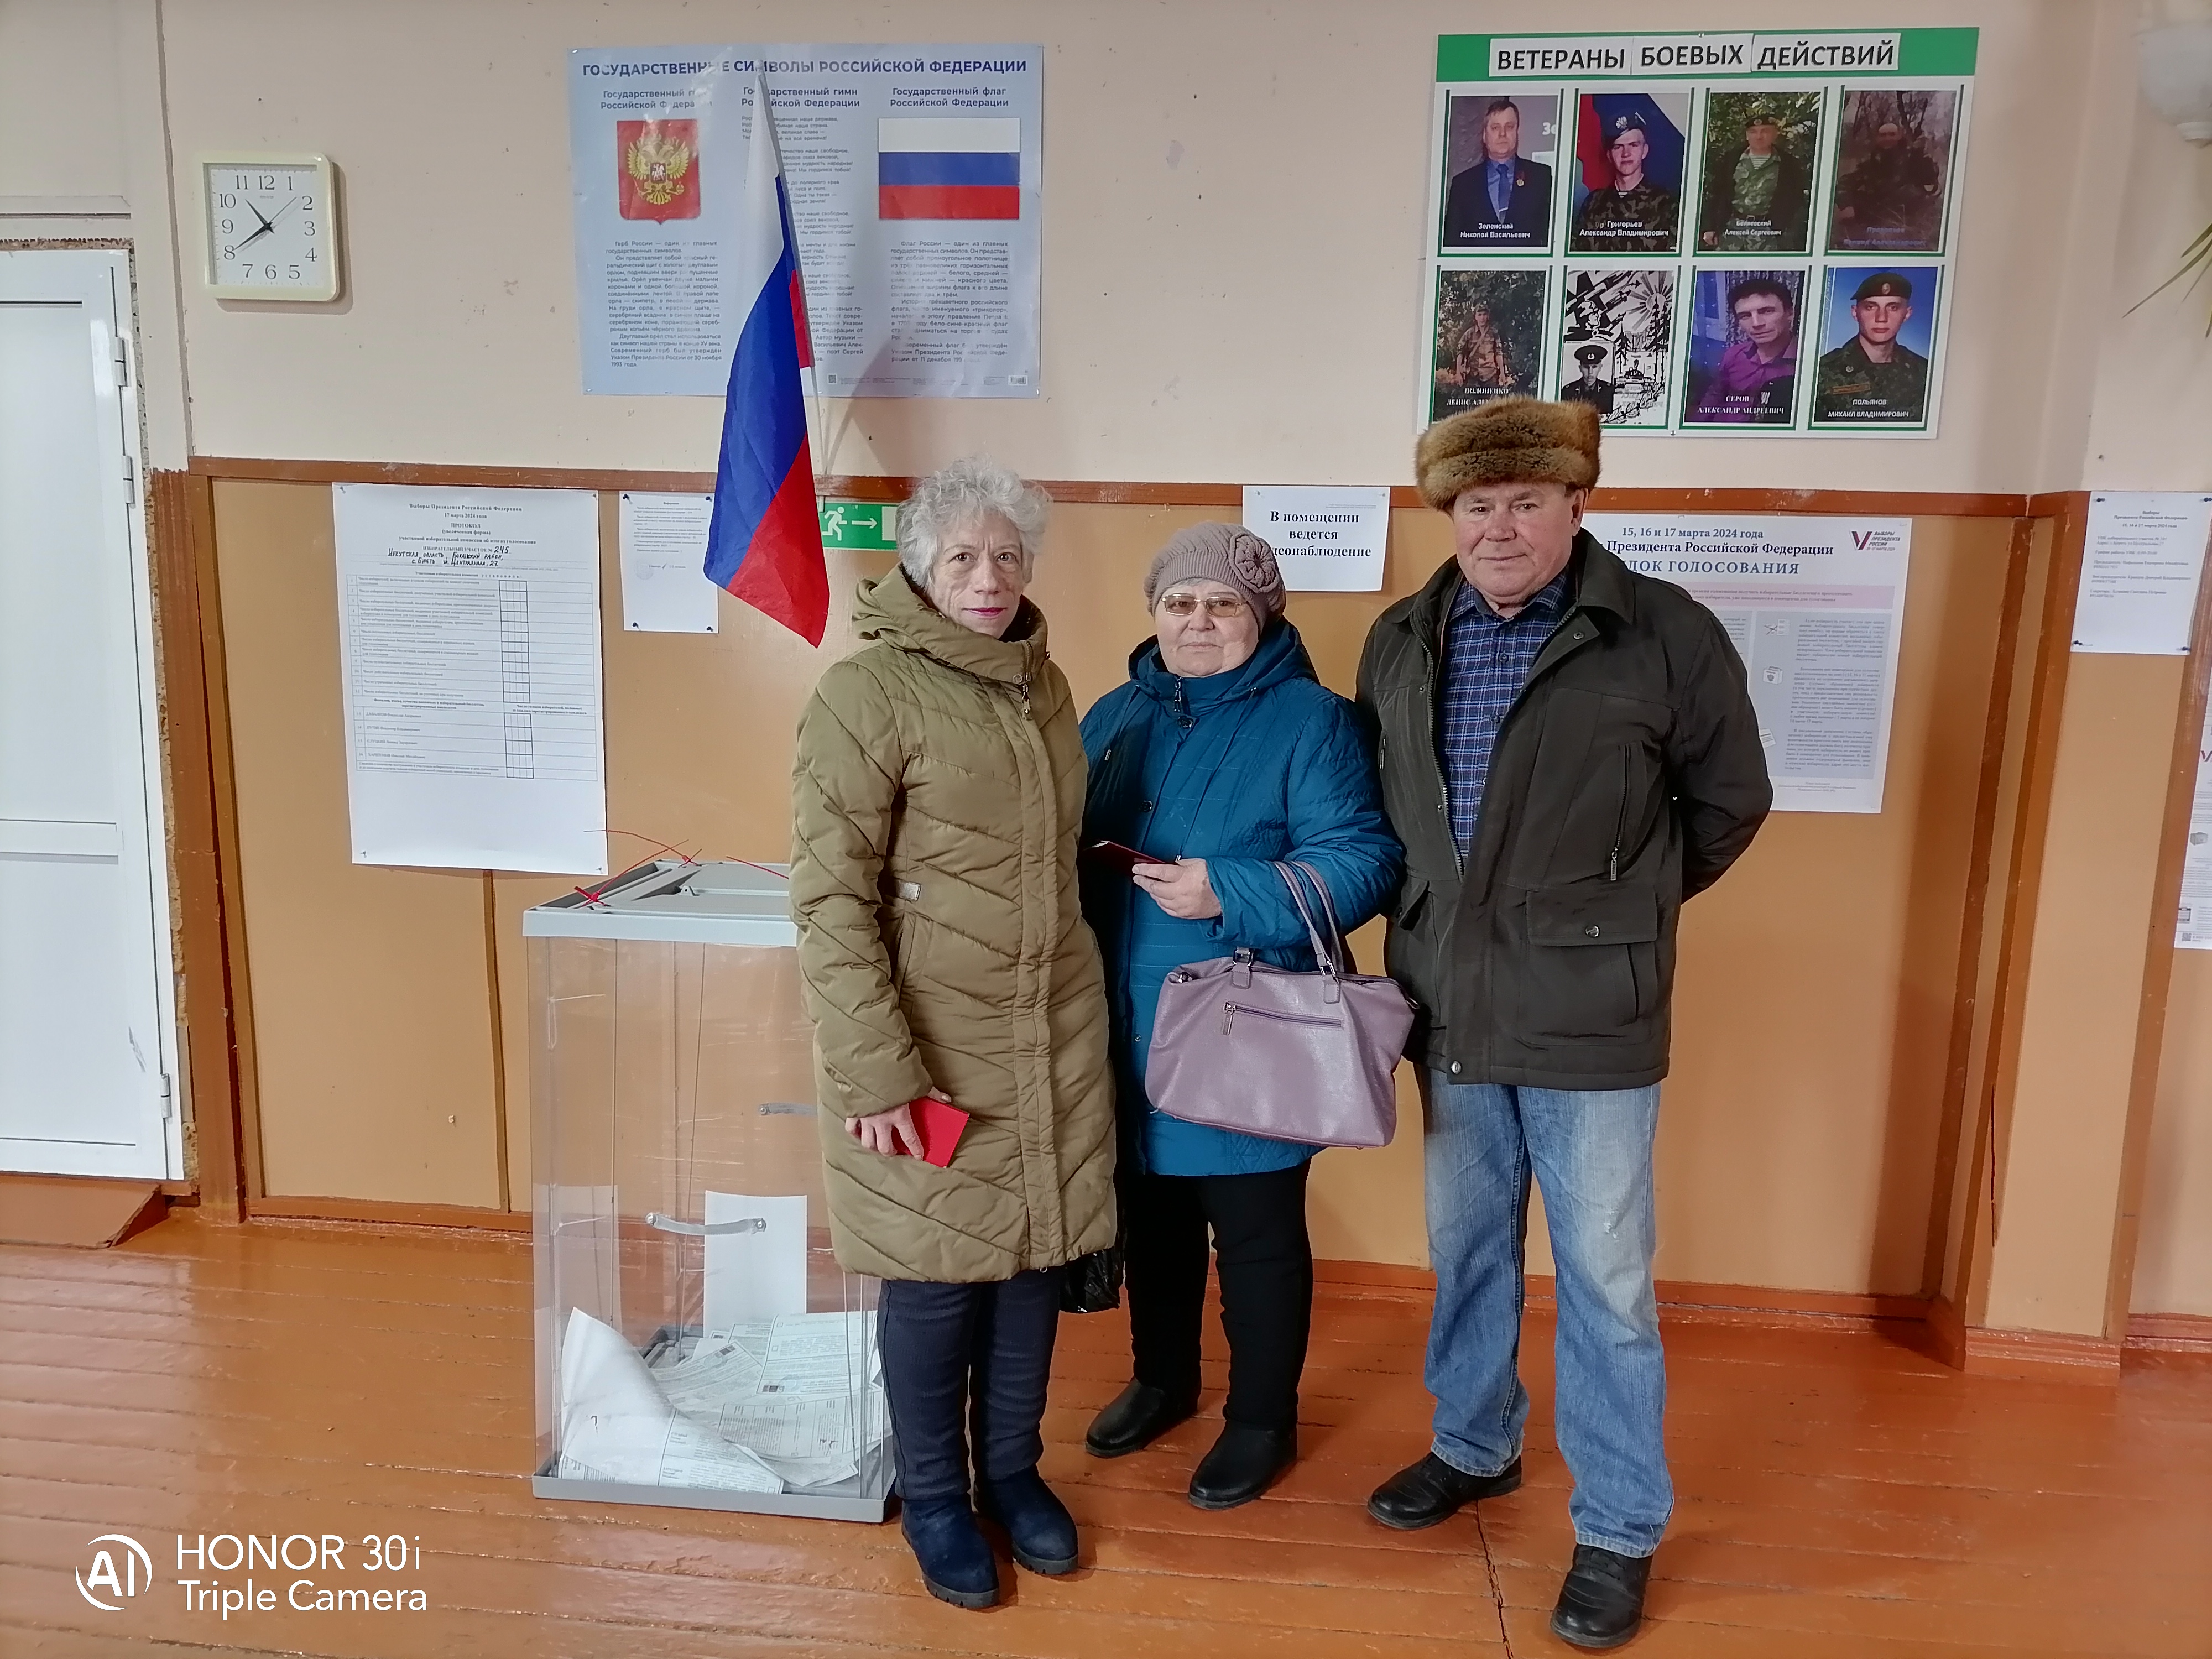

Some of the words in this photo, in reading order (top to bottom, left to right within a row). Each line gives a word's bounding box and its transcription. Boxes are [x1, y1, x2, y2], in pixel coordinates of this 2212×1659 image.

[1498, 49, 1624, 70] ВЕТЕРАНЫ
[1641, 45, 1743, 66] БОЕВЫХ
[1757, 40, 1893, 70] ДЕЙСТВИЙ
[583, 61, 730, 77] ГОСУДАРСТВЕННЕ
[820, 58, 924, 72] РОССИЙСКОЙ
[930, 61, 1026, 74] ФЕДЕРАЦИИ
[604, 90, 684, 100] Государственный
[893, 87, 978, 97] Государственный
[983, 87, 1006, 97] флаг
[601, 99, 656, 110] Российской
[804, 100, 859, 108] Федерации
[890, 98, 947, 107] Российской
[952, 99, 1008, 108] Федерации
[236, 175, 248, 190] 11
[259, 175, 274, 190] 12
[288, 176, 293, 191] 1
[220, 194, 236, 208] 10
[302, 196, 312, 210] 2
[222, 219, 233, 233] 9
[304, 221, 315, 236] 3
[224, 246, 236, 259] 8
[305, 248, 317, 262] 4
[242, 264, 253, 278] 7
[265, 265, 276, 279] 6
[289, 265, 300, 279] 5
[1271, 511, 1279, 521] В
[1284, 514, 1358, 524] помещении
[1290, 531, 1337, 540] ведется
[1623, 528, 1636, 538] 15,
[1641, 528, 1651, 536] 16
[1665, 528, 1676, 536] 17
[1678, 530, 1710, 539] марта
[1713, 529, 1737, 538] 2024
[1607, 540, 1681, 554] Президента
[1684, 542, 1758, 553] Российской
[1762, 544, 1833, 557] Федерации
[1668, 561, 1799, 574] ГОЛОСОВАНИЯ
